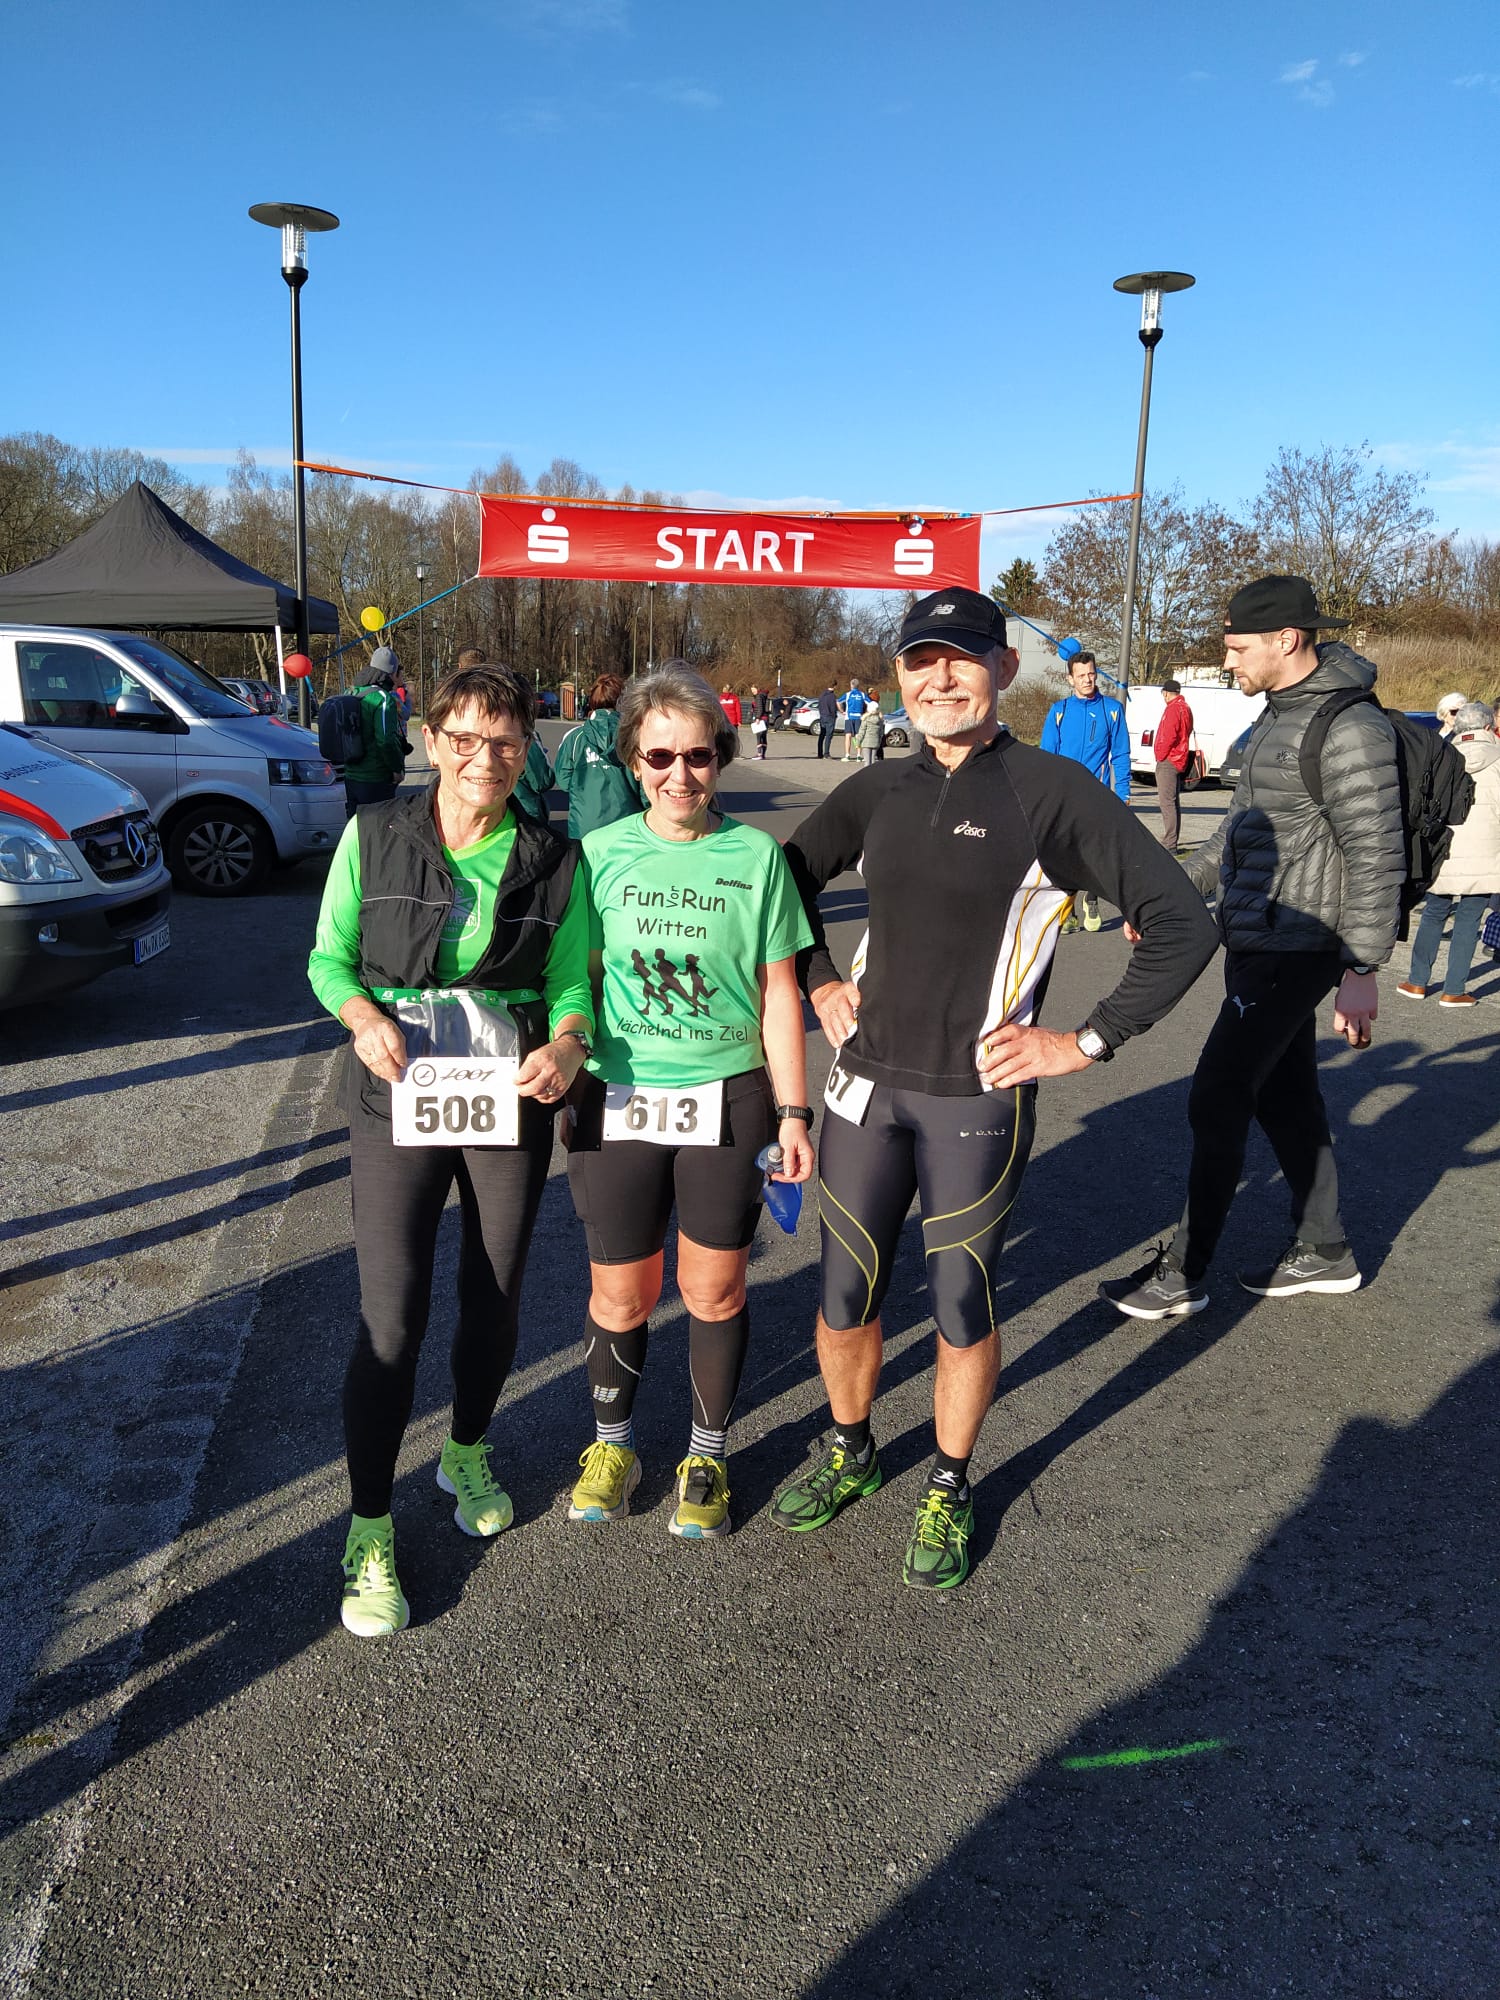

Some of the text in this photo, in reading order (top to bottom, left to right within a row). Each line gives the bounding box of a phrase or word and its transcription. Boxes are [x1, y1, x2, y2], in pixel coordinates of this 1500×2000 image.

[655, 526, 815, 573] START
[622, 884, 665, 907] Fun
[681, 888, 726, 913] Run
[715, 877, 753, 891] Delfina
[636, 916, 707, 940] Witten
[616, 1017, 748, 1041] lächelnd ins Ziel
[415, 1094, 496, 1134] 508
[624, 1094, 698, 1134] 613
